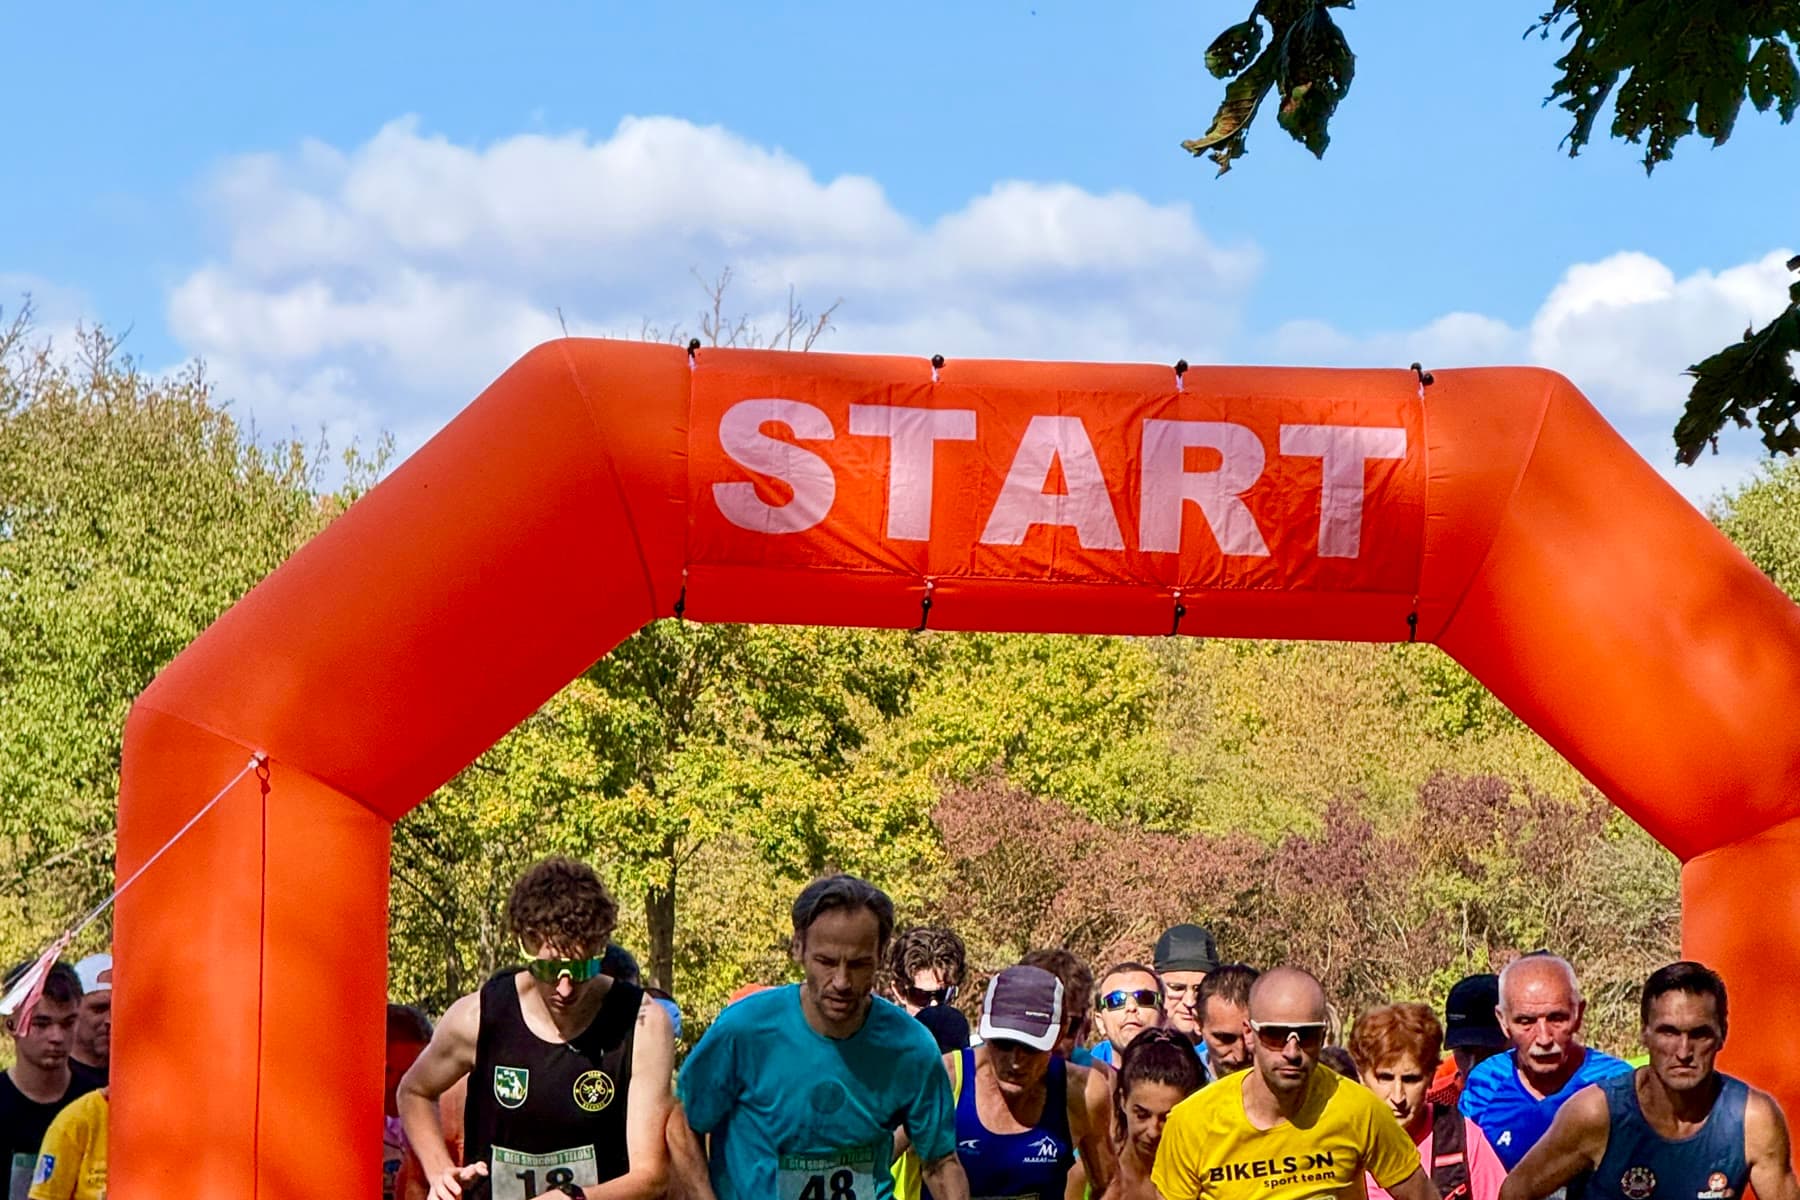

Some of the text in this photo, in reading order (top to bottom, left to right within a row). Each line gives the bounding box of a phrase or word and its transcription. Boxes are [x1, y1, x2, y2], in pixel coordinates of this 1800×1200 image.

[711, 398, 1407, 559] START
[1209, 1151, 1334, 1183] BIKELSON
[1264, 1170, 1336, 1190] sport team
